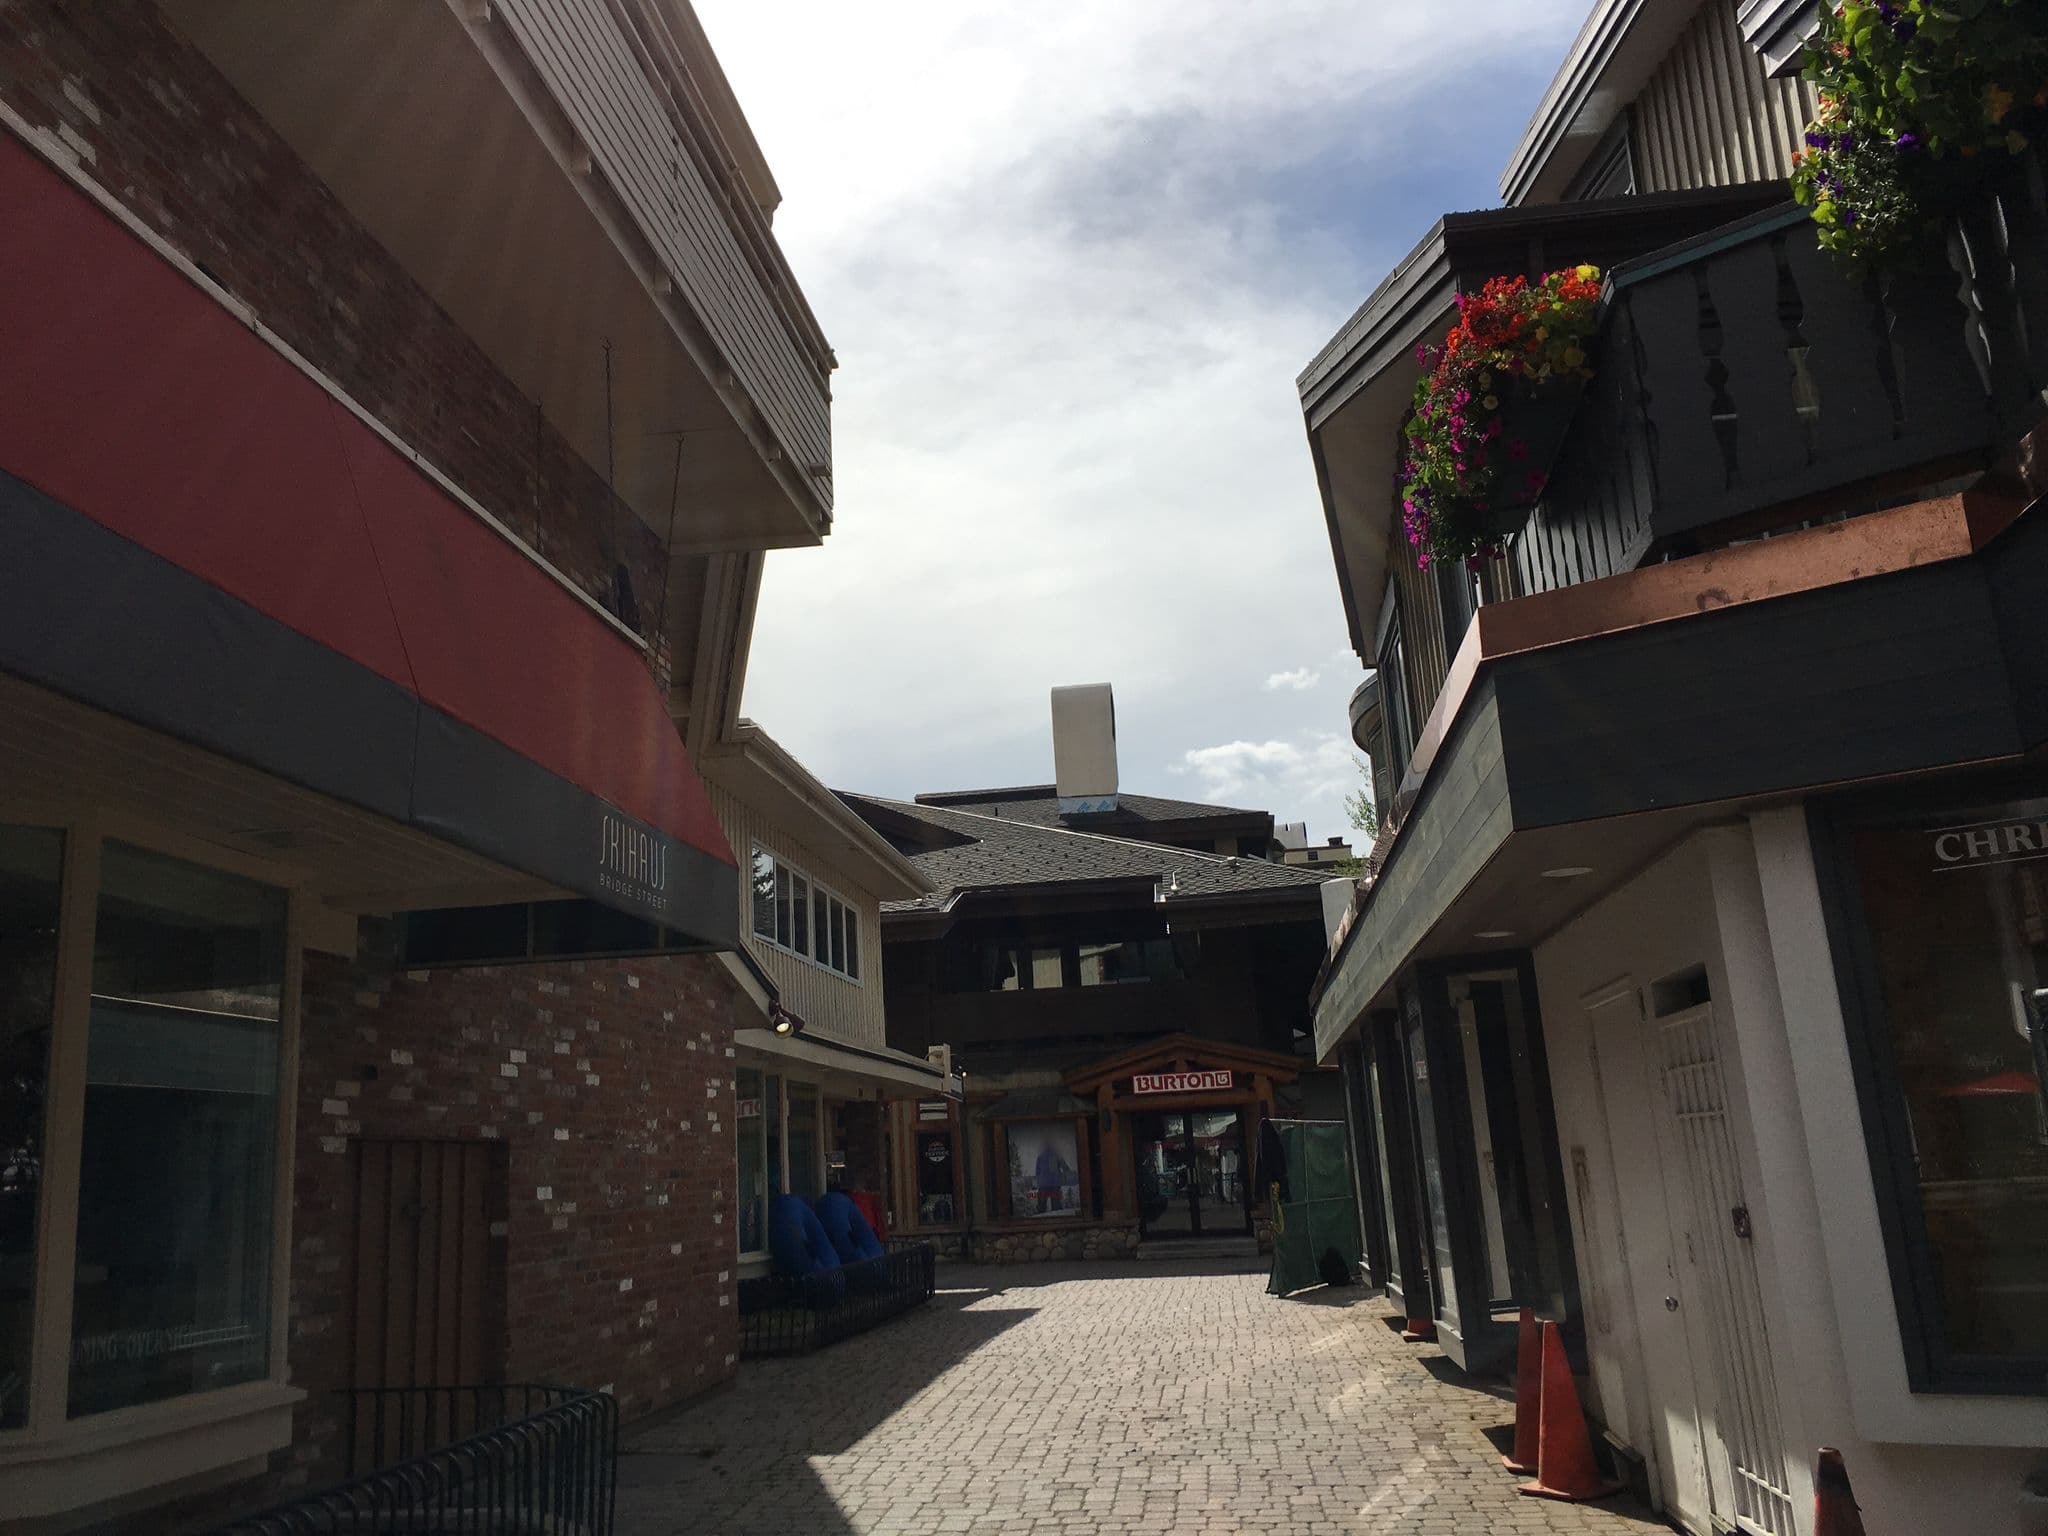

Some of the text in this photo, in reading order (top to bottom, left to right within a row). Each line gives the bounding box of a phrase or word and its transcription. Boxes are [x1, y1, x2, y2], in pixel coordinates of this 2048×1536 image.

[600, 815, 667, 890] SKIHAUS
[600, 872, 667, 910] BRIDGE STREET
[1135, 1073, 1214, 1092] BURTON
